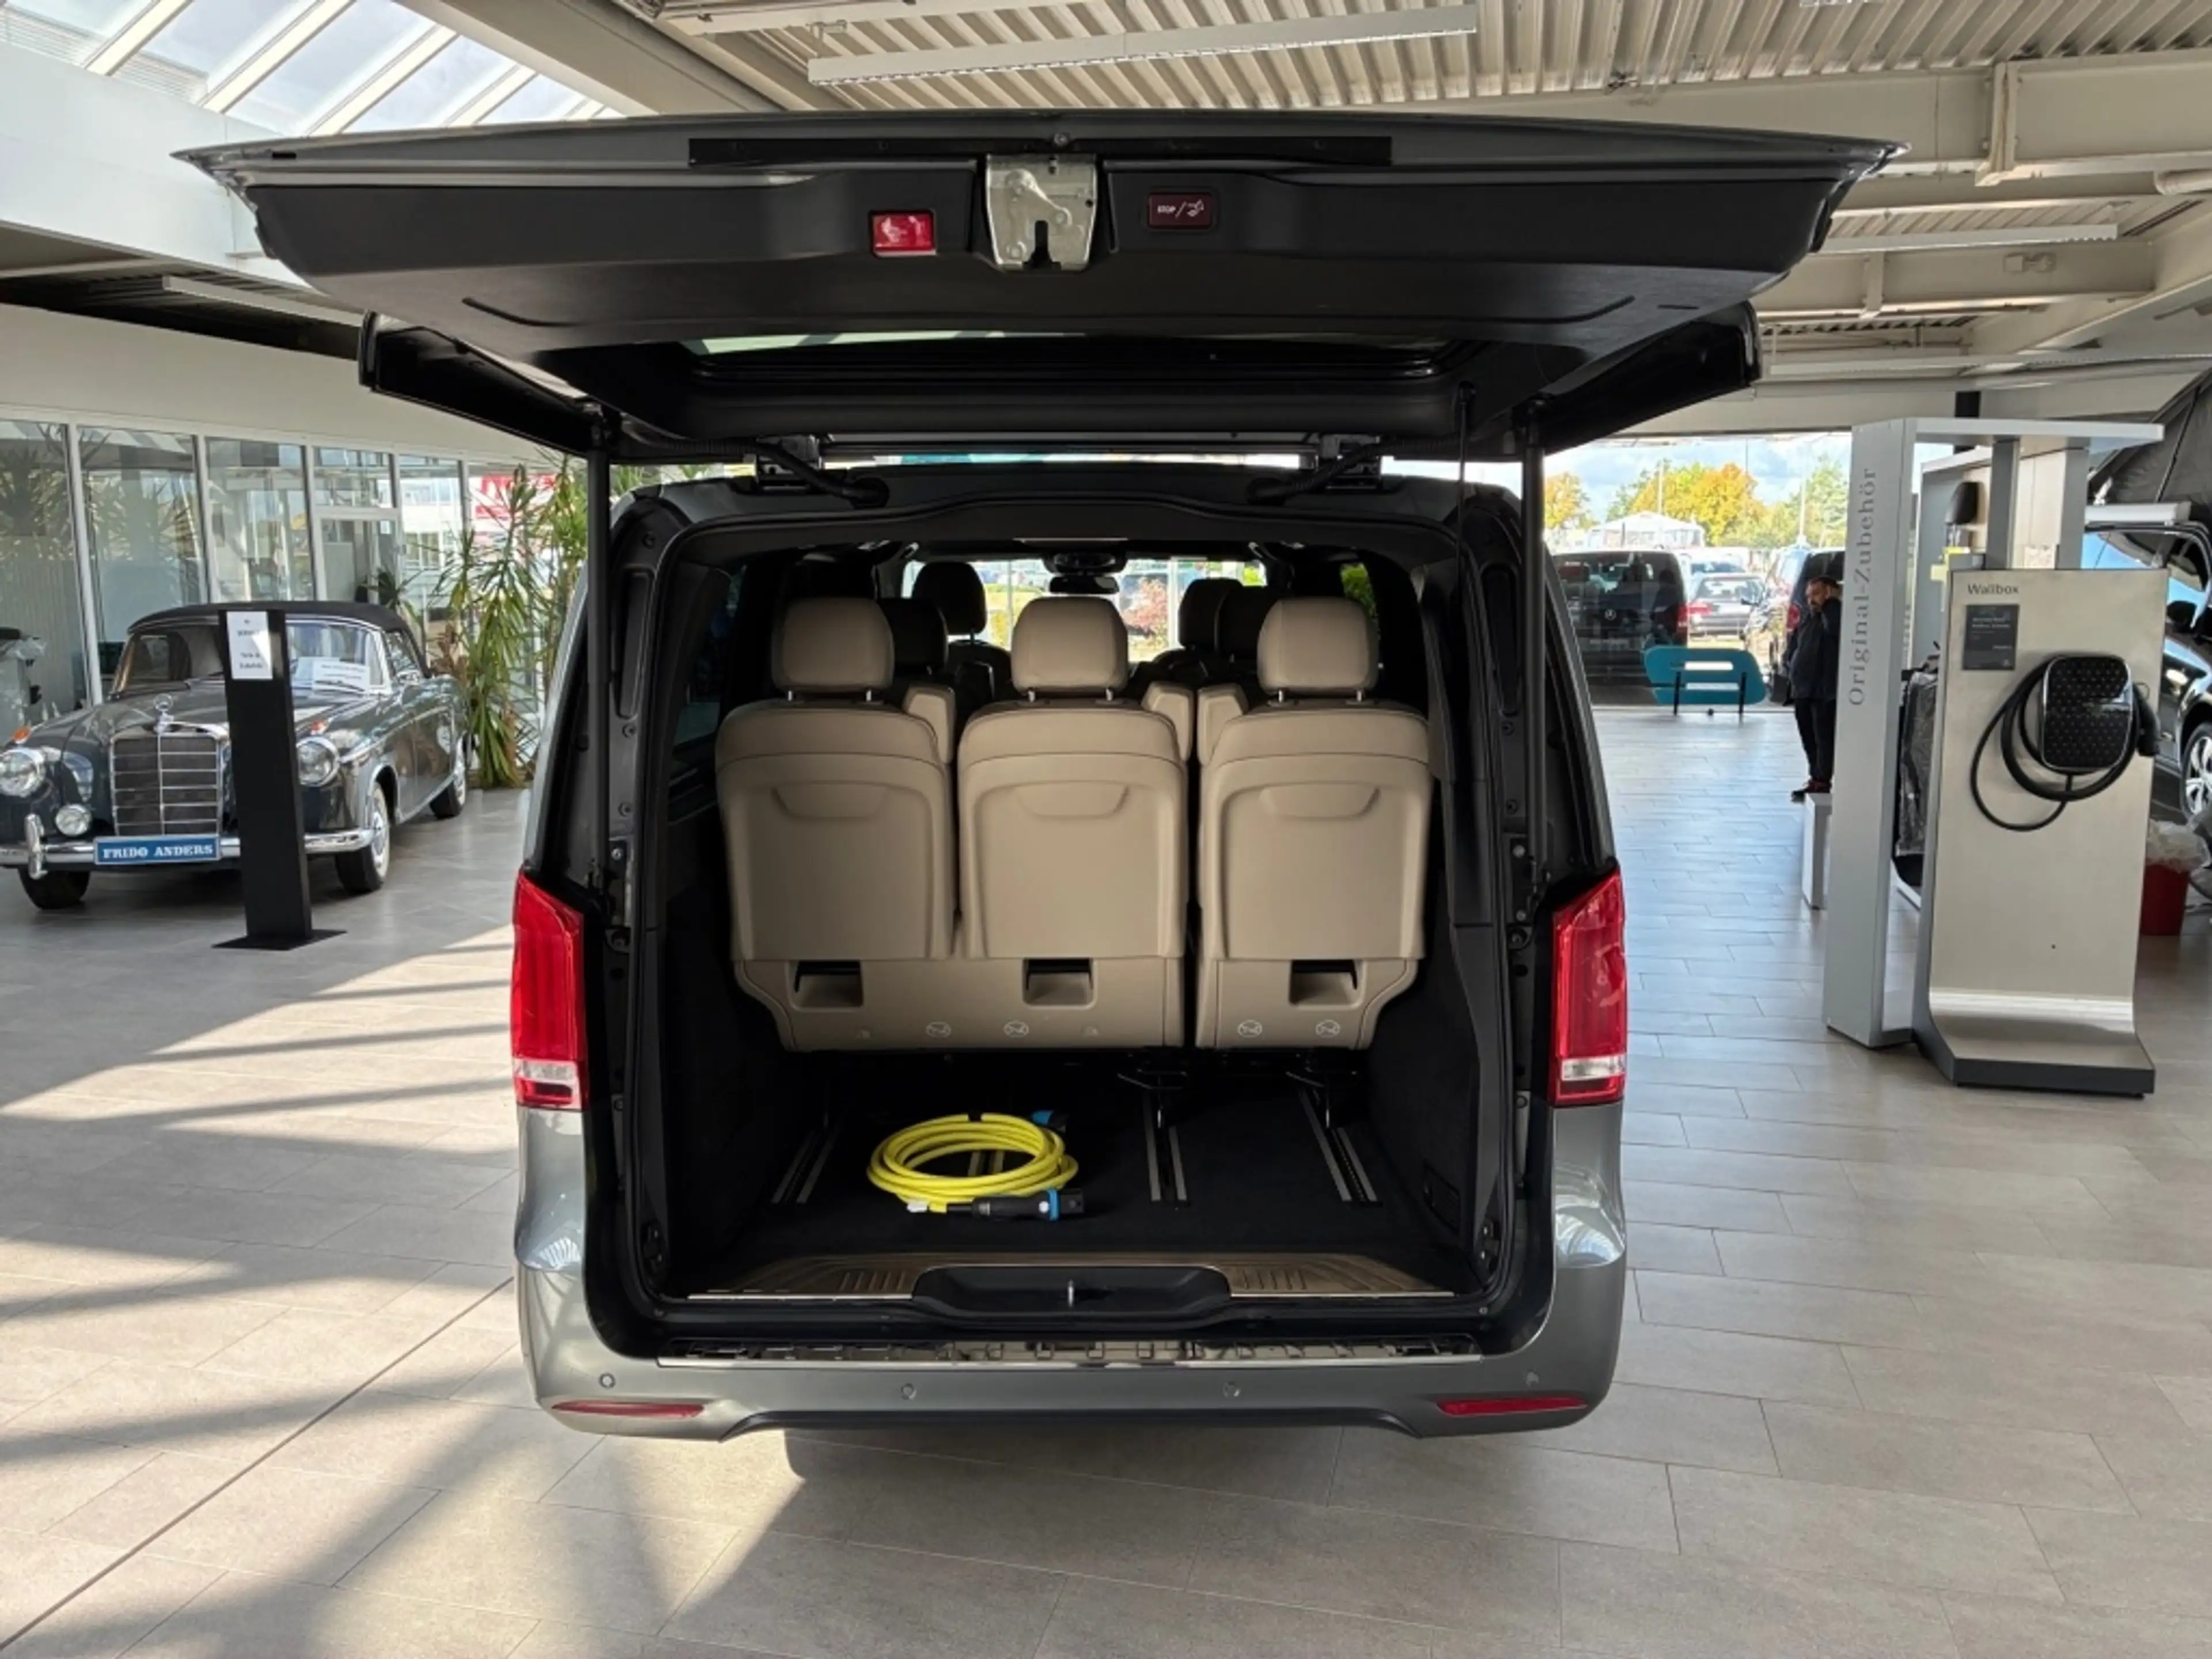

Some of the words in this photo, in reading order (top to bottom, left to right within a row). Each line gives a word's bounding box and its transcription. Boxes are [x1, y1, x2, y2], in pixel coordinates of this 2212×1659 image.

[1849, 468, 1876, 706] Original-Zubehör
[1968, 583, 2020, 595] Wallbox
[103, 847, 149, 859] FRIDO
[153, 844, 213, 857] ANDERS
